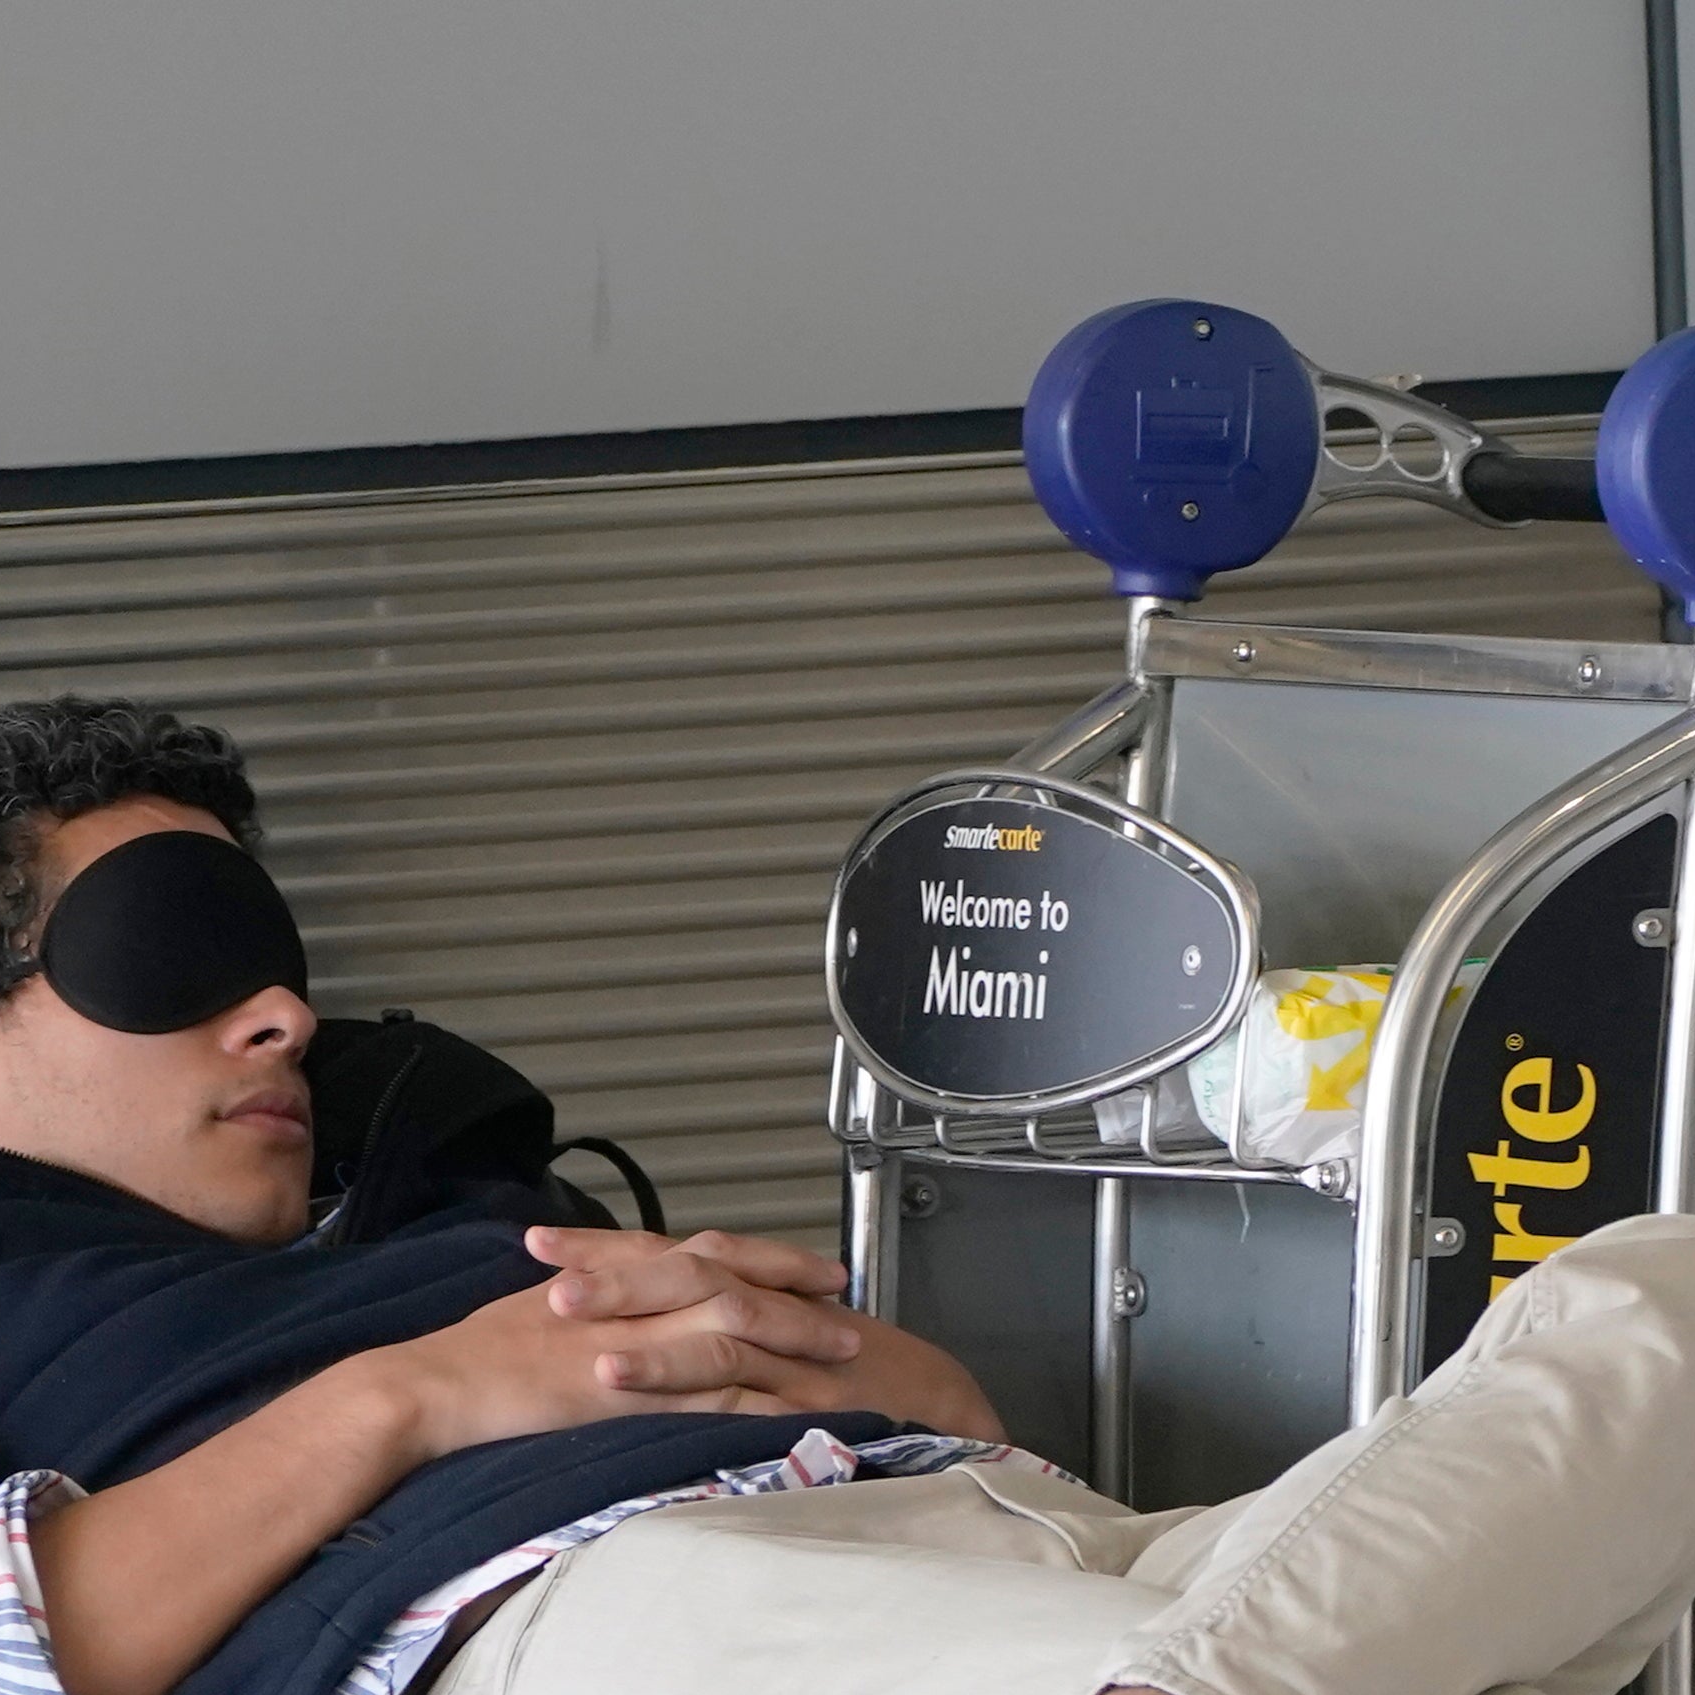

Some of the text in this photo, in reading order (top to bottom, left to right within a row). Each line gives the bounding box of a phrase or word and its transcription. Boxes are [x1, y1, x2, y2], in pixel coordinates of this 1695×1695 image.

[920, 879, 1070, 933] Welcome to
[923, 946, 1050, 1020] Miami
